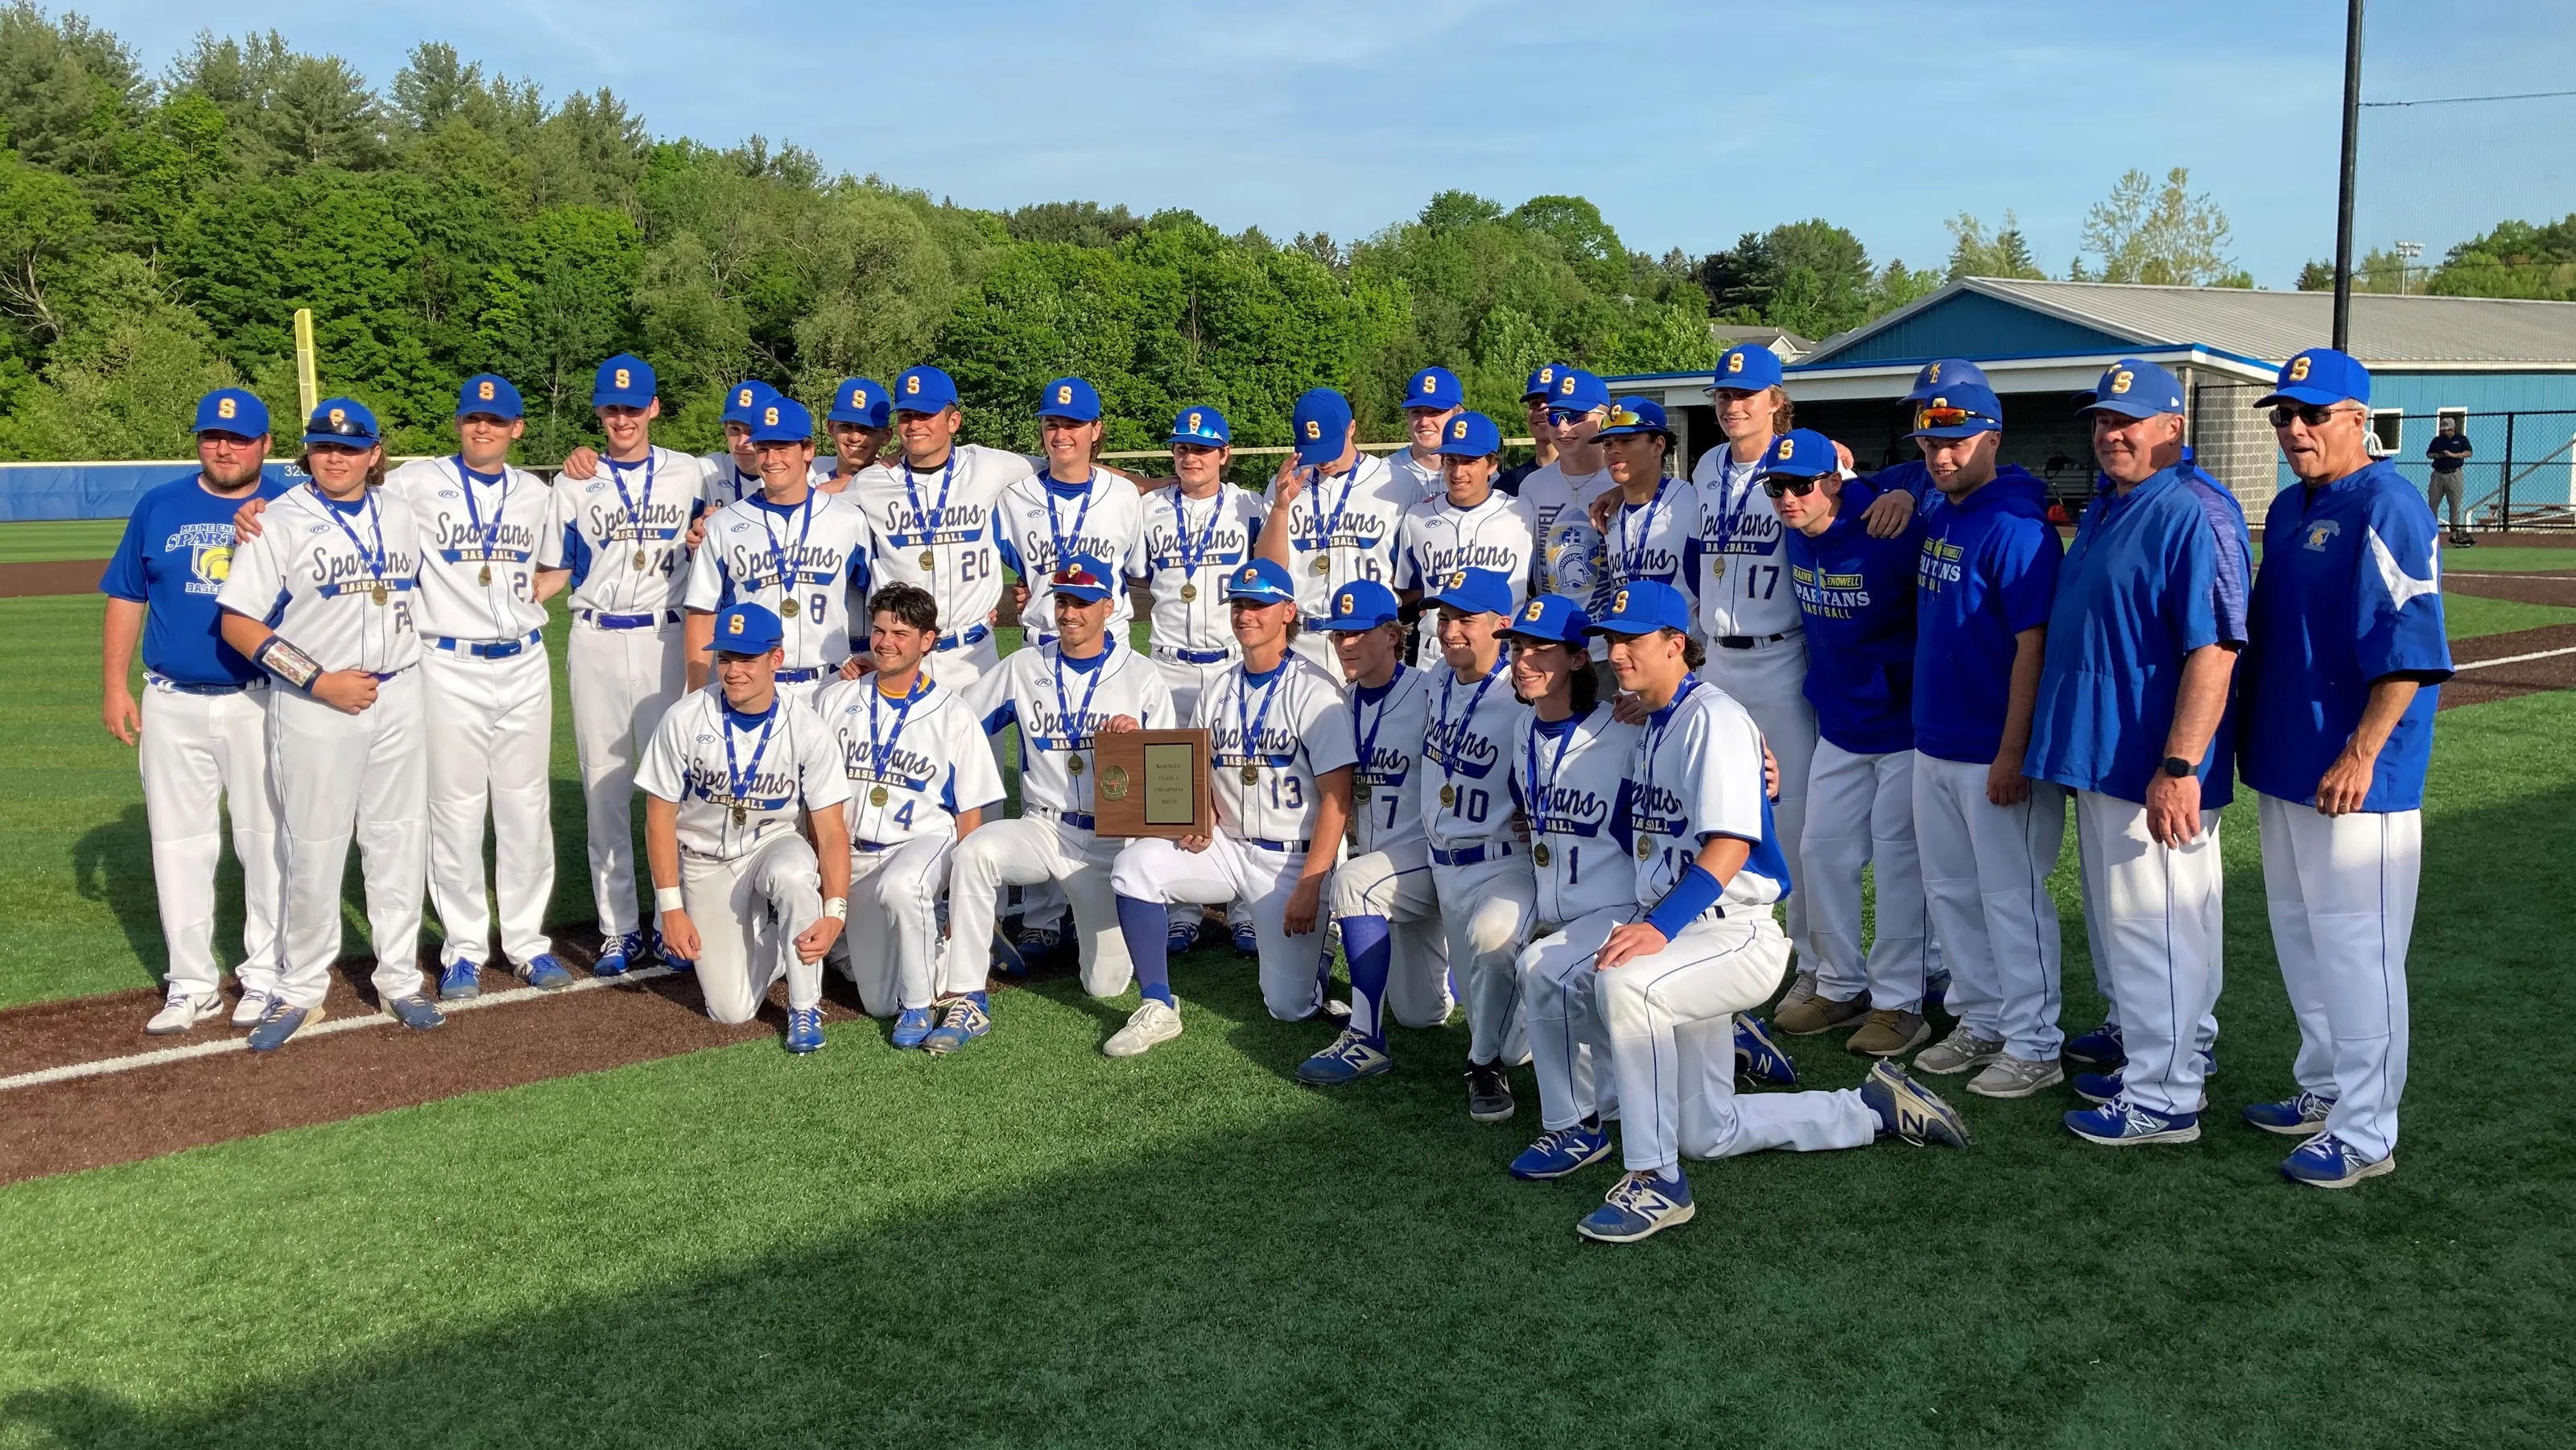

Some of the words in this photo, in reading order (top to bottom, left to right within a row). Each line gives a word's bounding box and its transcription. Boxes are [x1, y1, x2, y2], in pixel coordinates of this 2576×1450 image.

[1728, 353, 1744, 373] S
[2289, 357, 2312, 382] S
[615, 369, 630, 388] S
[906, 376, 920, 395] S
[1423, 376, 1436, 394] S
[1540, 368, 1554, 384] S
[1562, 377, 1575, 395] S
[2111, 371, 2134, 394] S
[479, 382, 495, 400] S
[739, 389, 753, 407] S
[852, 390, 867, 409] S
[1057, 386, 1072, 405] S
[218, 398, 236, 418] S
[765, 407, 779, 426] S
[1188, 412, 1202, 432] S
[1306, 420, 1321, 440] S
[1454, 420, 1468, 439] S
[1778, 440, 1794, 460] S
[180, 523, 215, 533] MAINE
[591, 496, 684, 539] Spatans
[886, 501, 986, 535] Spans
[1289, 505, 1385, 540] Spans
[1699, 503, 1782, 541] Spaans
[436, 511, 534, 550] Spaans
[613, 530, 661, 539] ASEALL
[908, 532, 964, 544] BABALL
[1027, 531, 1115, 566] Spaans
[1311, 537, 1359, 547] BEBALL
[1706, 542, 1757, 553] BAEBALL
[312, 547, 414, 585] Spans
[461, 551, 517, 560] BASBALL
[648, 548, 675, 578] 14
[961, 548, 989, 582] 20
[1169, 555, 1221, 567] BAALL
[1423, 538, 1517, 577] Spartans
[1610, 541, 1678, 574] patns
[761, 572, 815, 587] BASALL
[1354, 556, 1381, 583] 16
[340, 580, 396, 593] BASEBLL
[1448, 572, 1467, 589] S
[1747, 564, 1781, 600] 17
[1827, 576, 1859, 587] ENDWELL
[810, 593, 827, 625] 8
[1340, 594, 1354, 614] S
[1525, 601, 1545, 622] S
[1612, 590, 1629, 613] S
[394, 600, 414, 634] 24
[729, 614, 745, 634] S
[1029, 700, 1110, 739] Spaan
[1423, 697, 1498, 761] Spatns
[1052, 740, 1094, 750] BASBA
[1212, 717, 1298, 755] Spaans
[838, 727, 937, 779] Spaans
[1223, 756, 1268, 766] BASAL
[1427, 745, 1463, 772] BASELL
[691, 757, 795, 795] Spaans
[848, 768, 906, 787] BASEALL
[1270, 775, 1303, 809] 13
[1381, 795, 1398, 829] 7
[1452, 783, 1489, 823] 10
[894, 799, 915, 831] 4
[1569, 846, 1579, 884] 1
[1348, 1047, 1372, 1069] N
[1757, 1053, 1773, 1074] N
[1901, 1109, 1926, 1137] N
[1564, 1139, 1590, 1161] N
[1632, 1194, 1670, 1220] N
